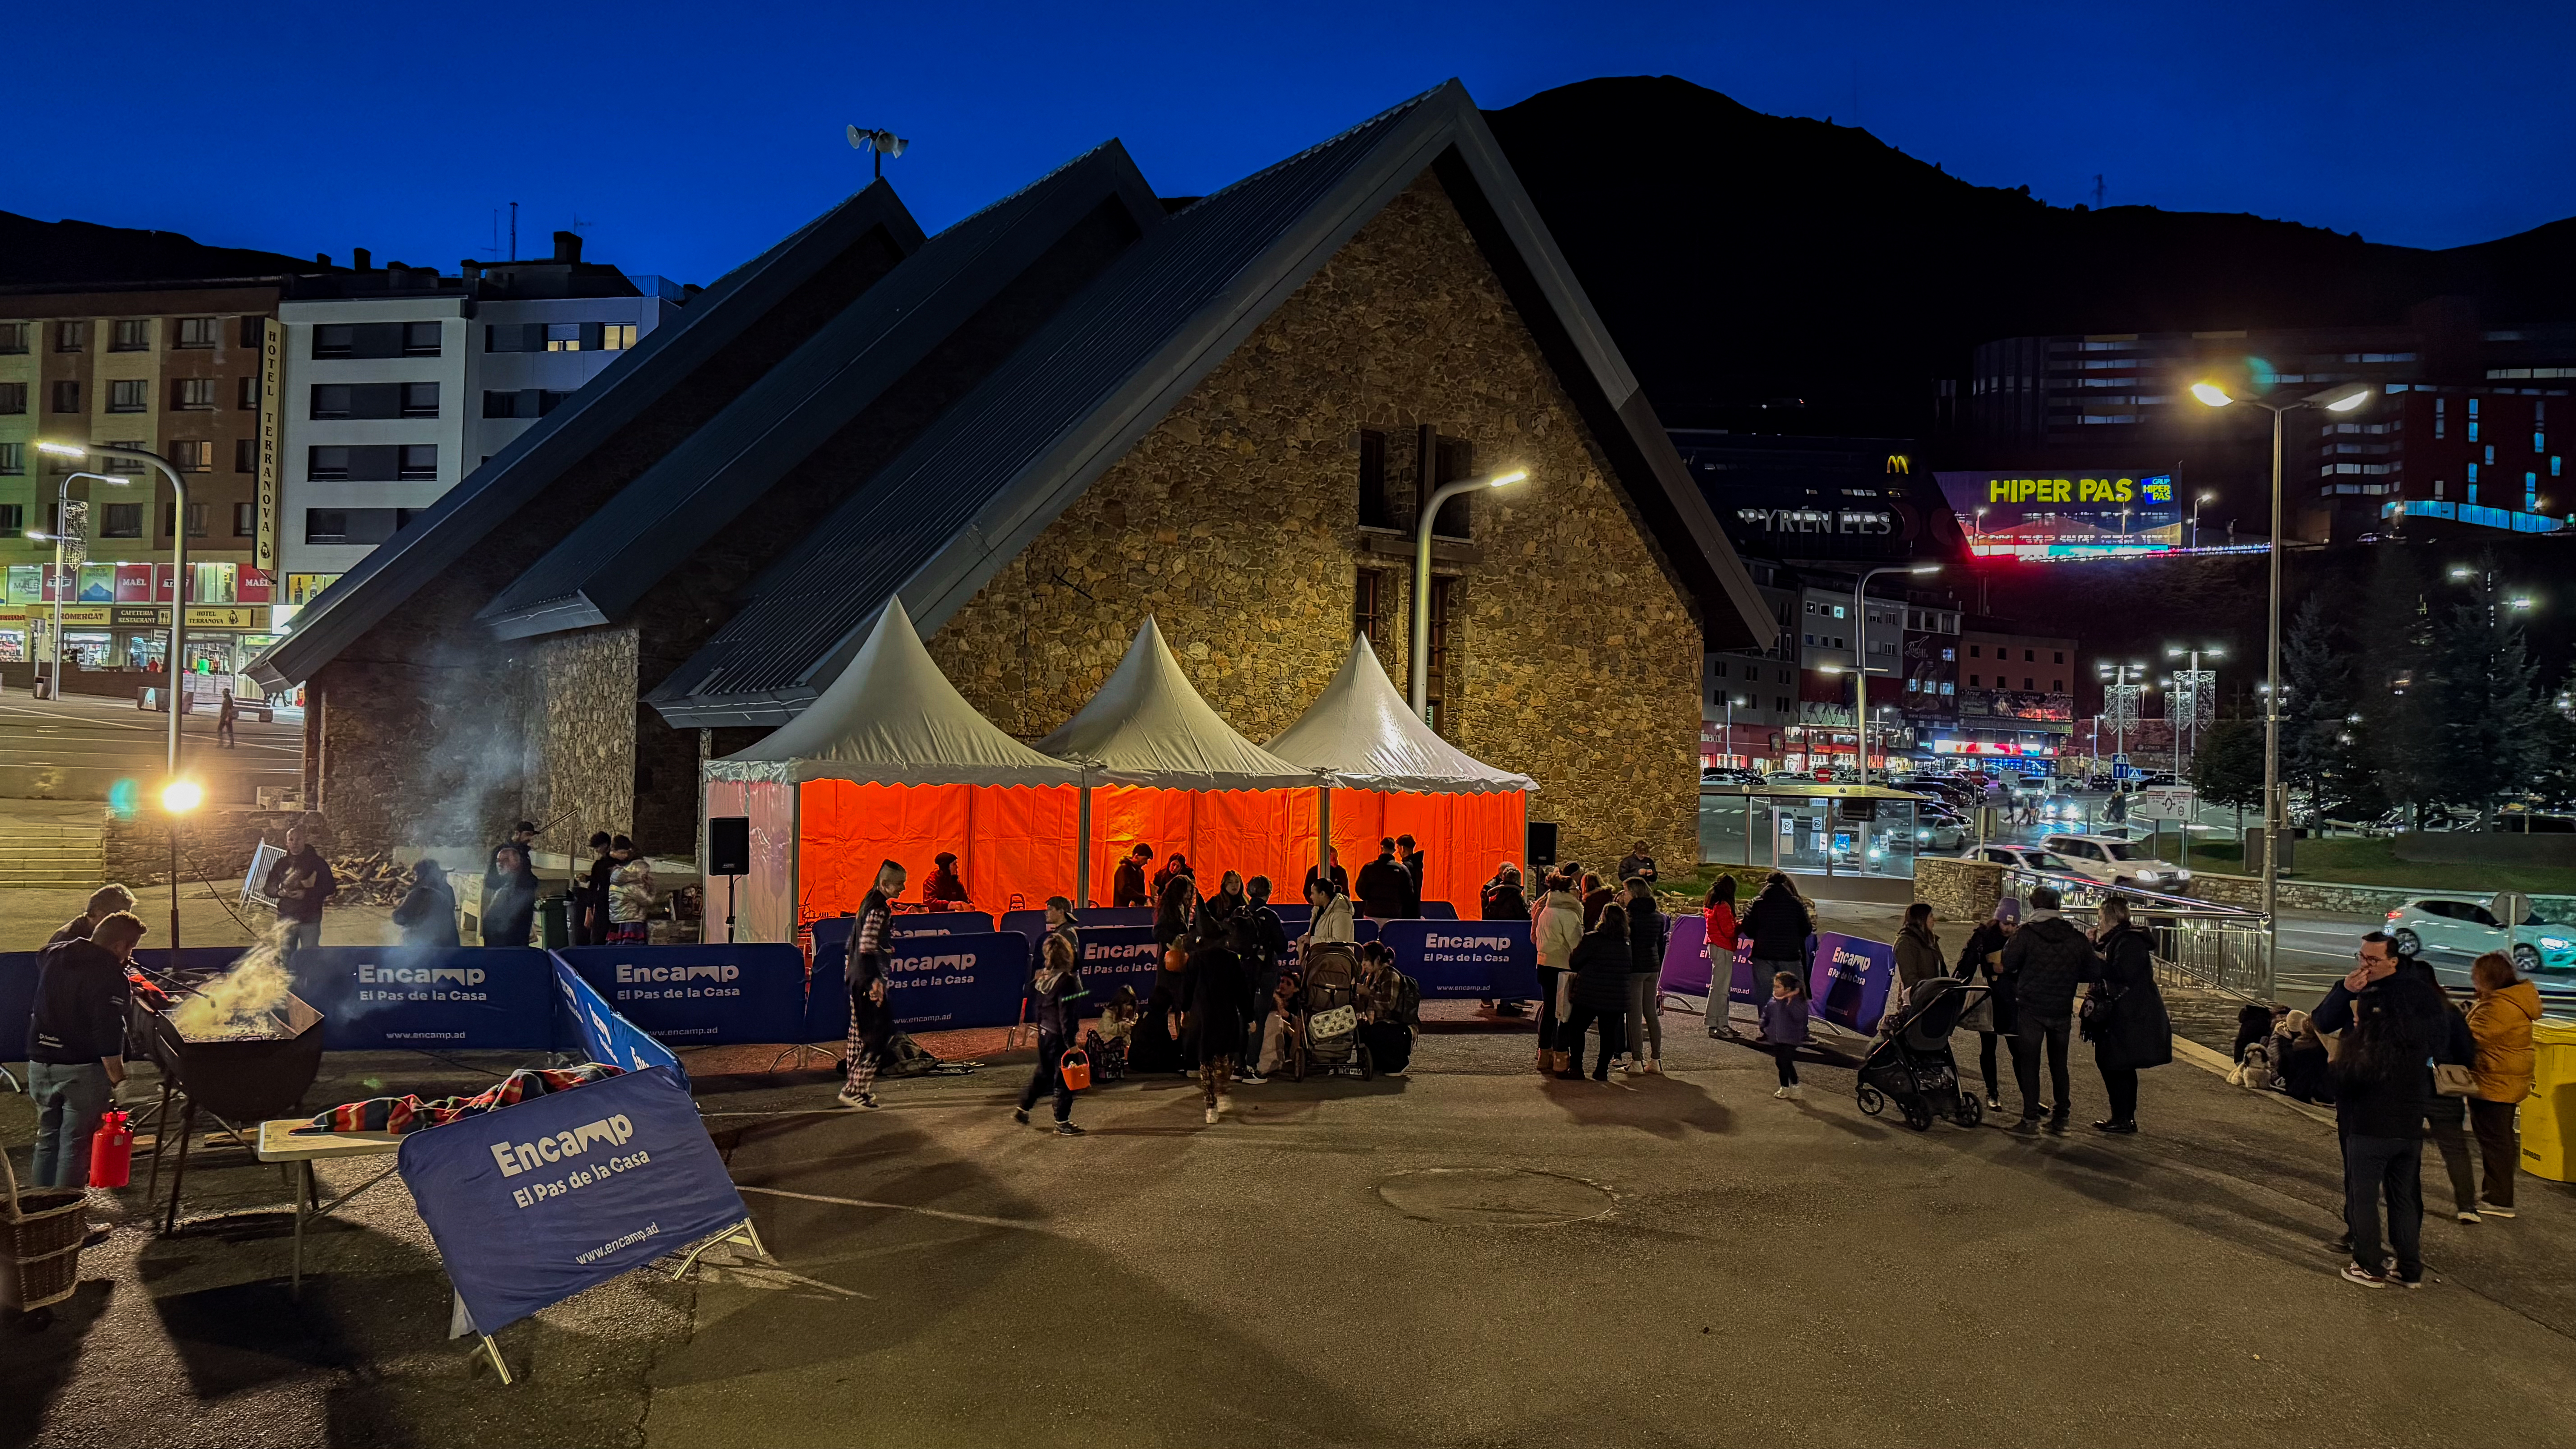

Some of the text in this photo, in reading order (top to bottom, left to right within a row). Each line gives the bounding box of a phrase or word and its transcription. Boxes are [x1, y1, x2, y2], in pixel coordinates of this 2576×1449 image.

[261, 331, 276, 532] HOTEL TERRANOVA
[1990, 478, 2133, 502] HIPER PAS
[2143, 484, 2170, 493] HIPER
[2153, 492, 2171, 500] PAS
[1426, 933, 1511, 951] Encamp
[1084, 943, 1158, 960] Encam
[1832, 947, 1871, 972] Encamp
[890, 953, 976, 972] ncamp
[1082, 966, 1091, 975] El
[1094, 966, 1113, 974] Pas
[1116, 964, 1129, 973] de
[1132, 963, 1142, 972] la
[359, 964, 485, 986] Encamp
[616, 964, 739, 983] Encamp
[911, 978, 928, 987] de
[931, 976, 942, 985] la
[945, 975, 974, 984] Casa
[1827, 967, 1834, 976] El
[1853, 975, 1865, 985] Casa
[360, 990, 487, 1001] El Pas de la Casa
[617, 987, 740, 1000] El Pas de la Casa
[386, 1031, 466, 1040] www.encamp.ad
[490, 1114, 633, 1178] Encamp
[512, 1150, 650, 1209] El Pas de la Casa
[575, 1222, 659, 1265] www.encamp.ad
